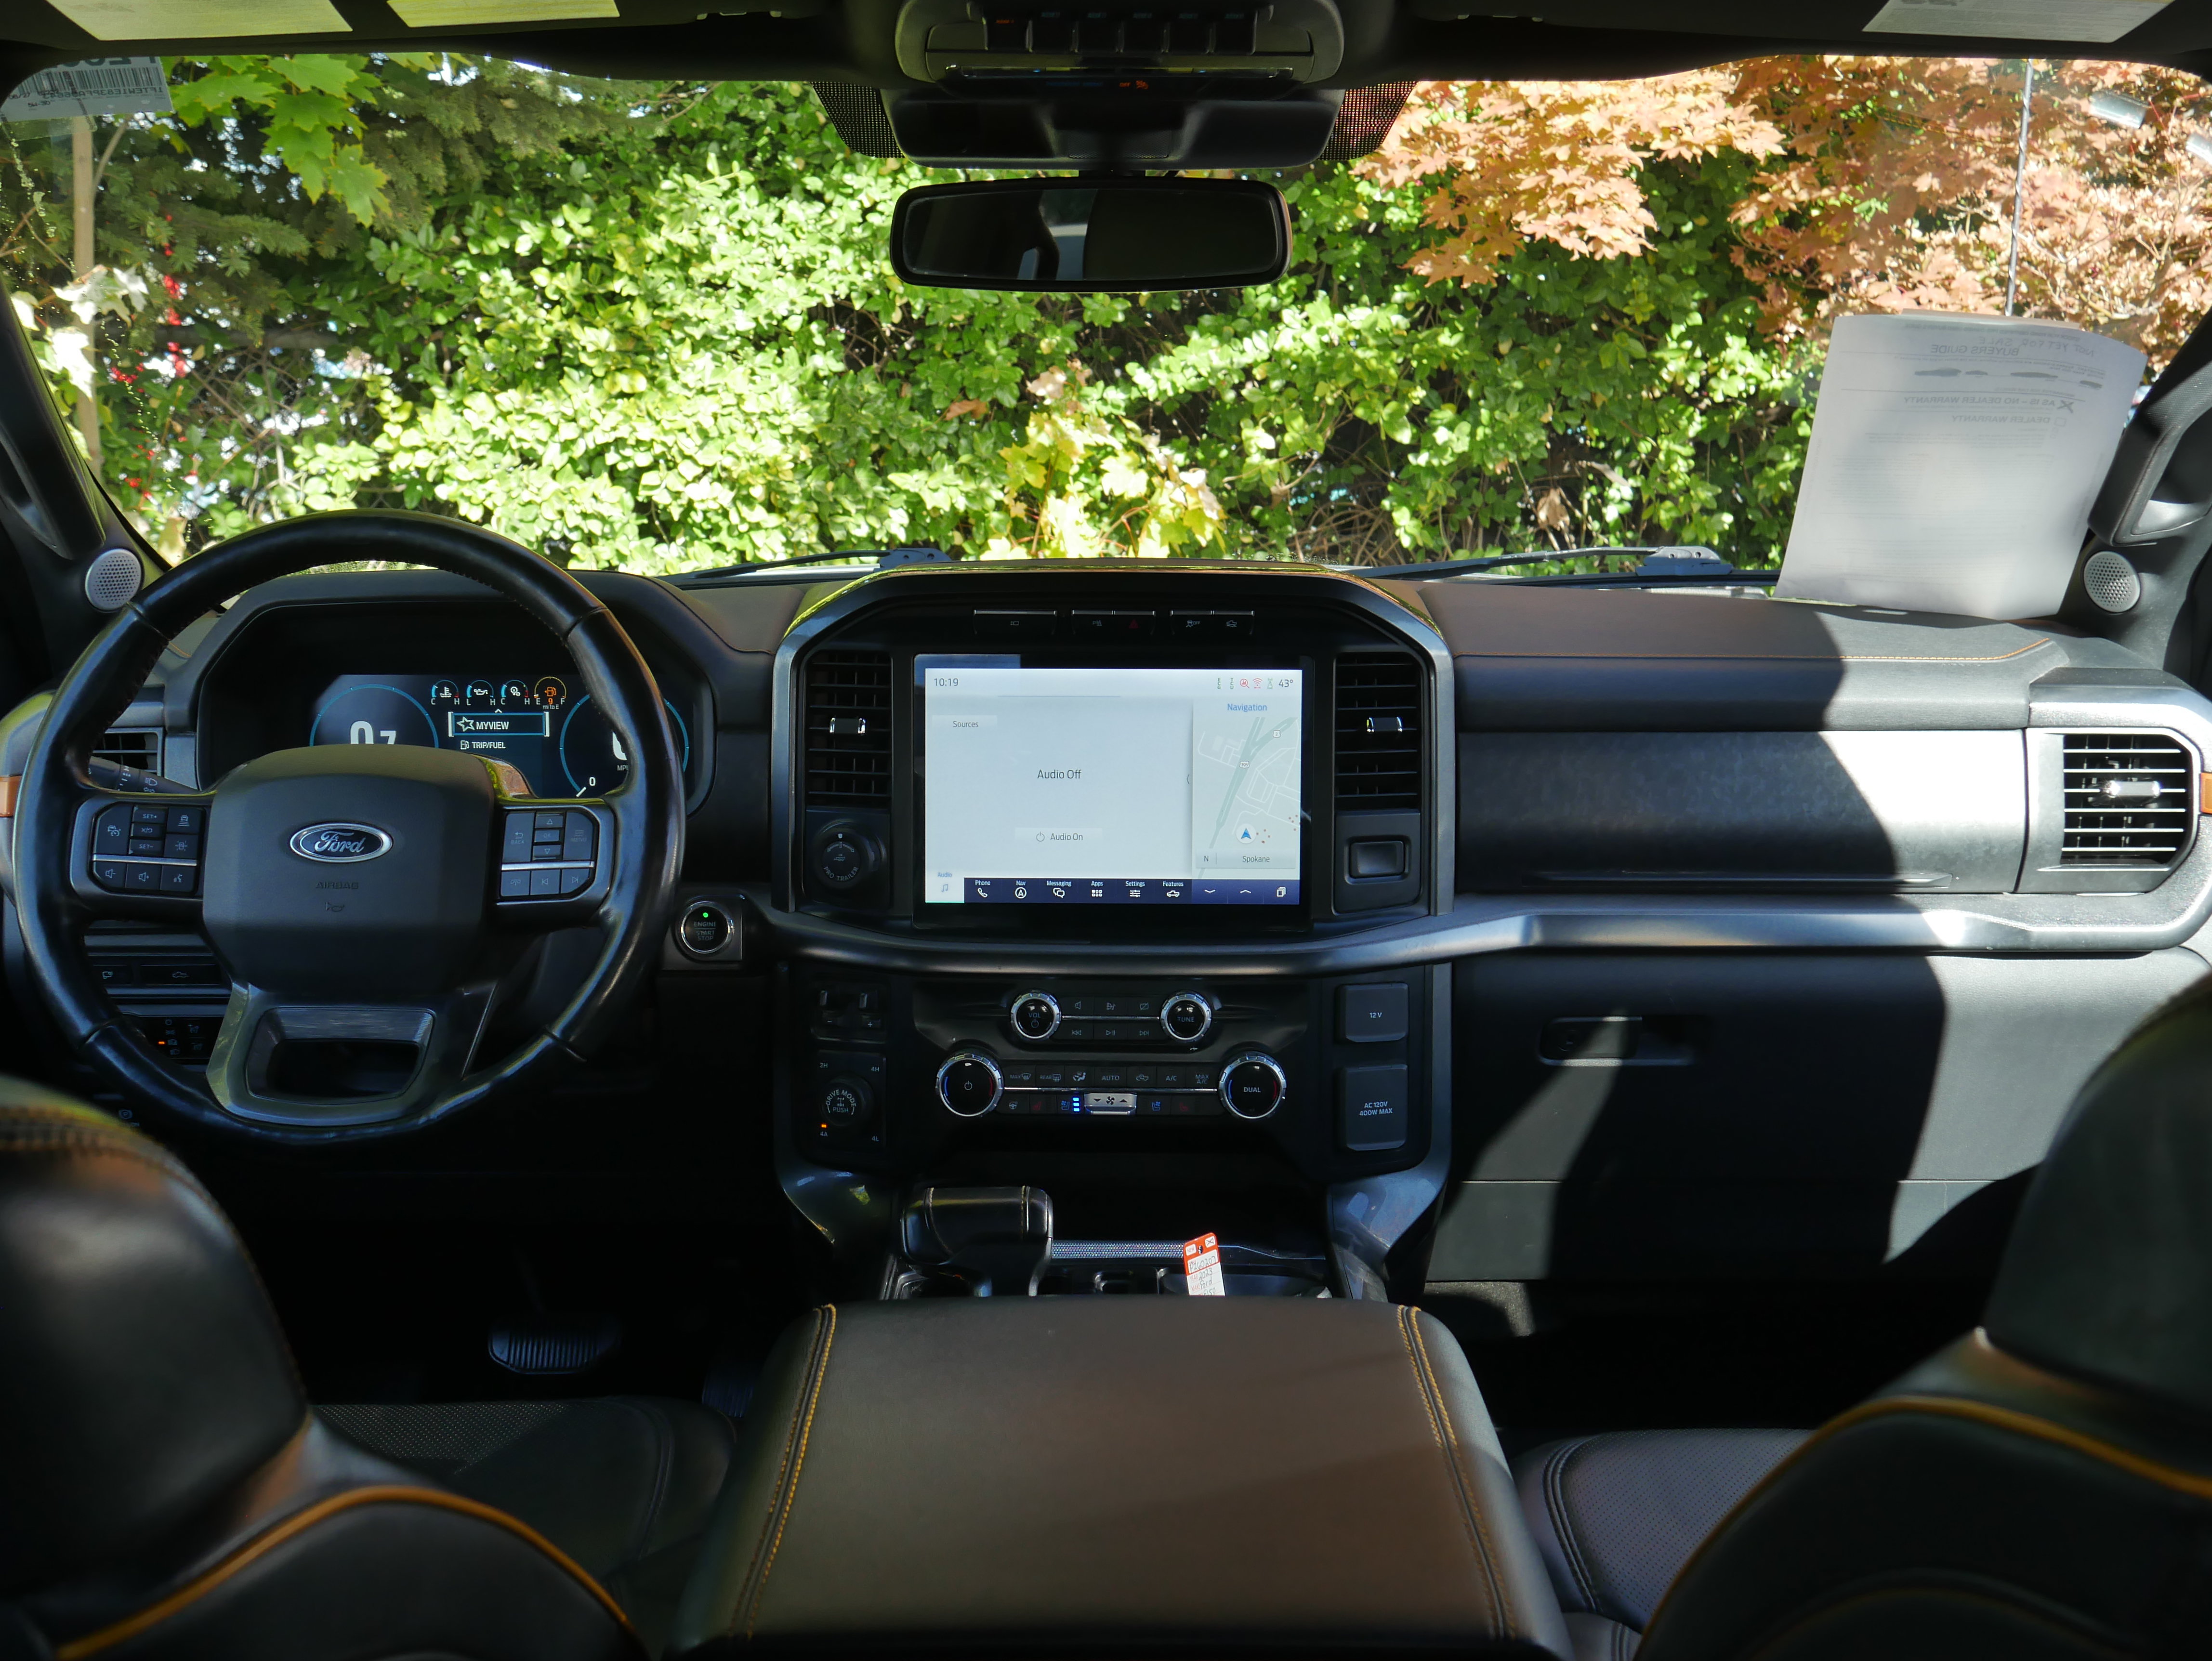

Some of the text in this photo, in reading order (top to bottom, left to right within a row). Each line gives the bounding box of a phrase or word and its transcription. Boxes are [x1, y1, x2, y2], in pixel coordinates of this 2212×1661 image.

[934, 678, 959, 686] 10:19
[1278, 679, 1293, 687] 43°
[1227, 703, 1267, 712] Navigation
[476, 722, 509, 730] MYVIEW
[1037, 769, 1082, 779] Audio Off
[589, 777, 596, 787] 0
[315, 831, 366, 853] Ford
[823, 866, 859, 881] PRO TRAILER
[316, 881, 359, 889] AIRBAG
[826, 1089, 857, 1107] DRIVE MODE
